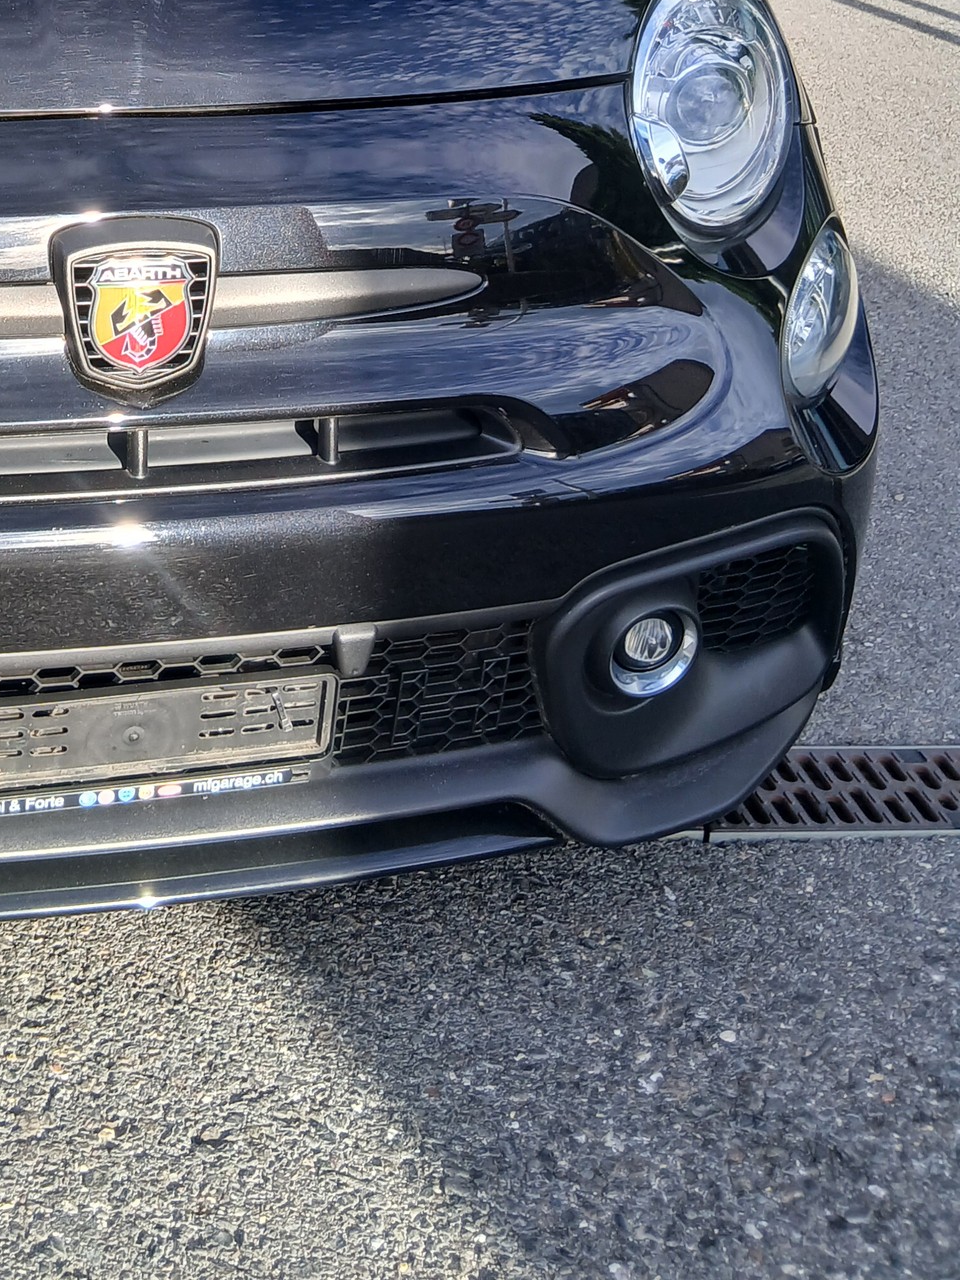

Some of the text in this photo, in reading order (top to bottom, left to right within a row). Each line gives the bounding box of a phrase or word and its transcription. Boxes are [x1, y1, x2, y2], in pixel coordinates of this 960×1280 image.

[100, 266, 182, 281] ABARTH
[9, 799, 21, 811] &
[25, 796, 66, 811] Forte
[193, 770, 284, 793] mfgarage.ch
